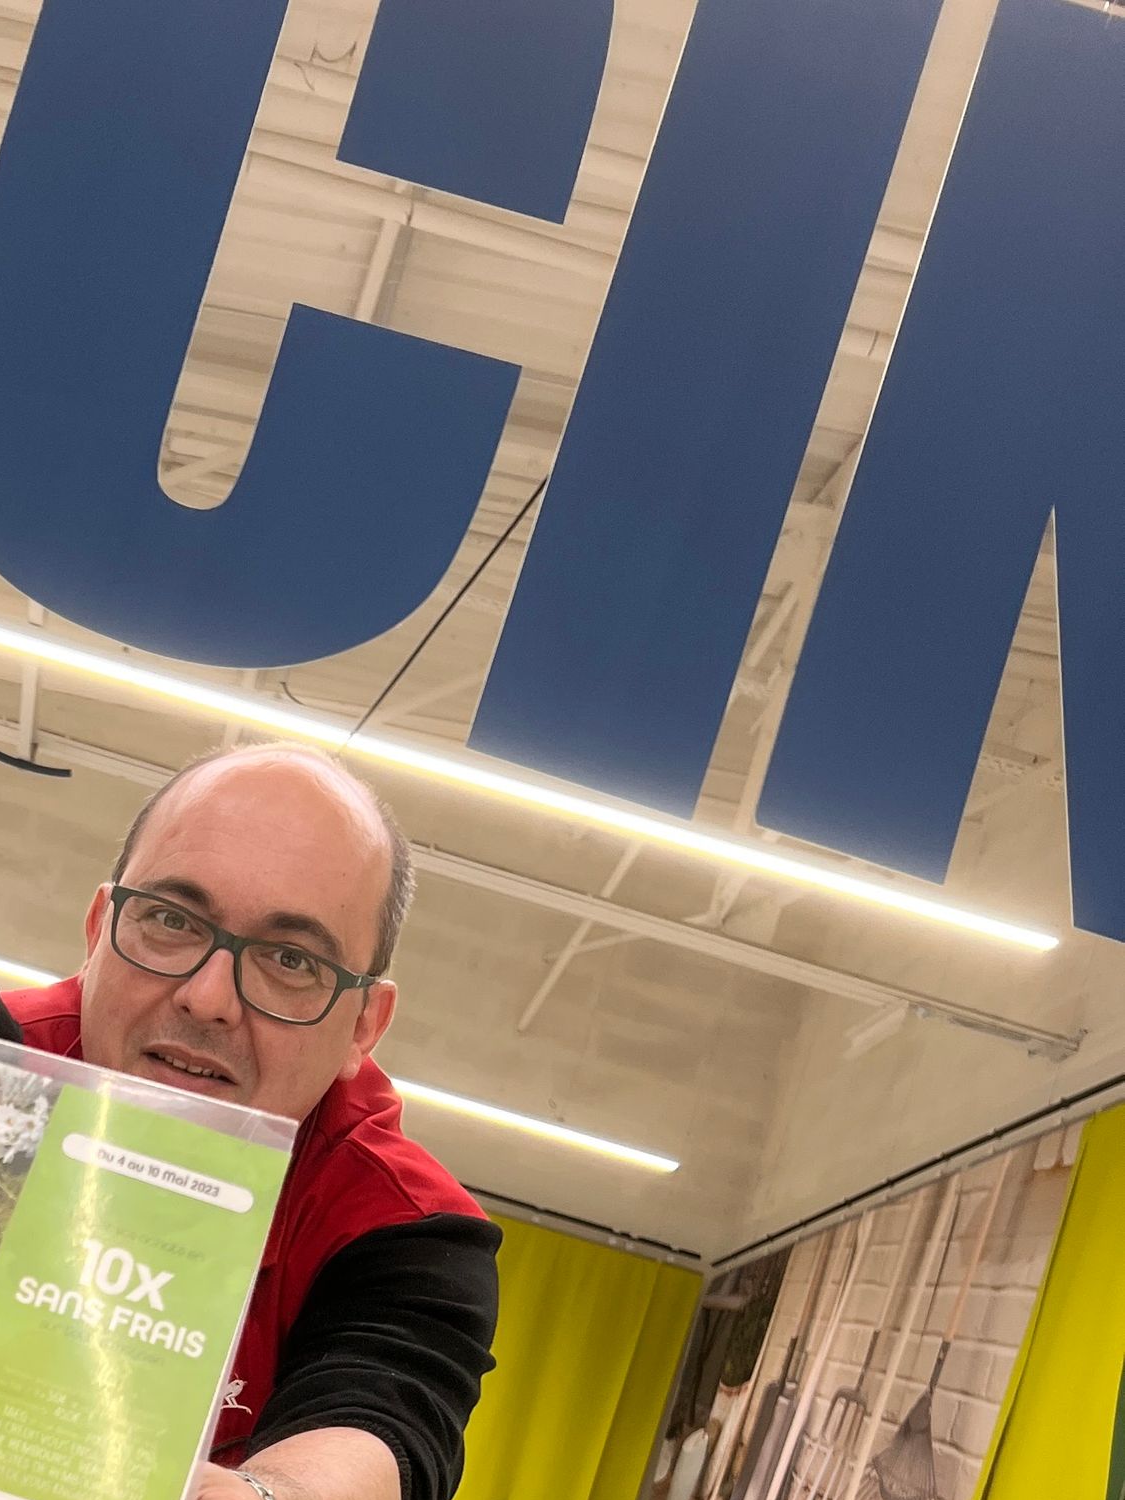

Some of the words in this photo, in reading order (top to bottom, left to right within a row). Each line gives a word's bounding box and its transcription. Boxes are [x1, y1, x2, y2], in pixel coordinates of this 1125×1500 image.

[117, 1155, 125, 1168] 4
[127, 1160, 145, 1173] au
[147, 1164, 159, 1179] 10
[161, 1170, 189, 1187] Mai
[190, 1179, 220, 1198] 2023
[78, 1238, 175, 1311] 10X
[15, 1276, 106, 1326] SANS
[108, 1305, 206, 1358] FRAIS
